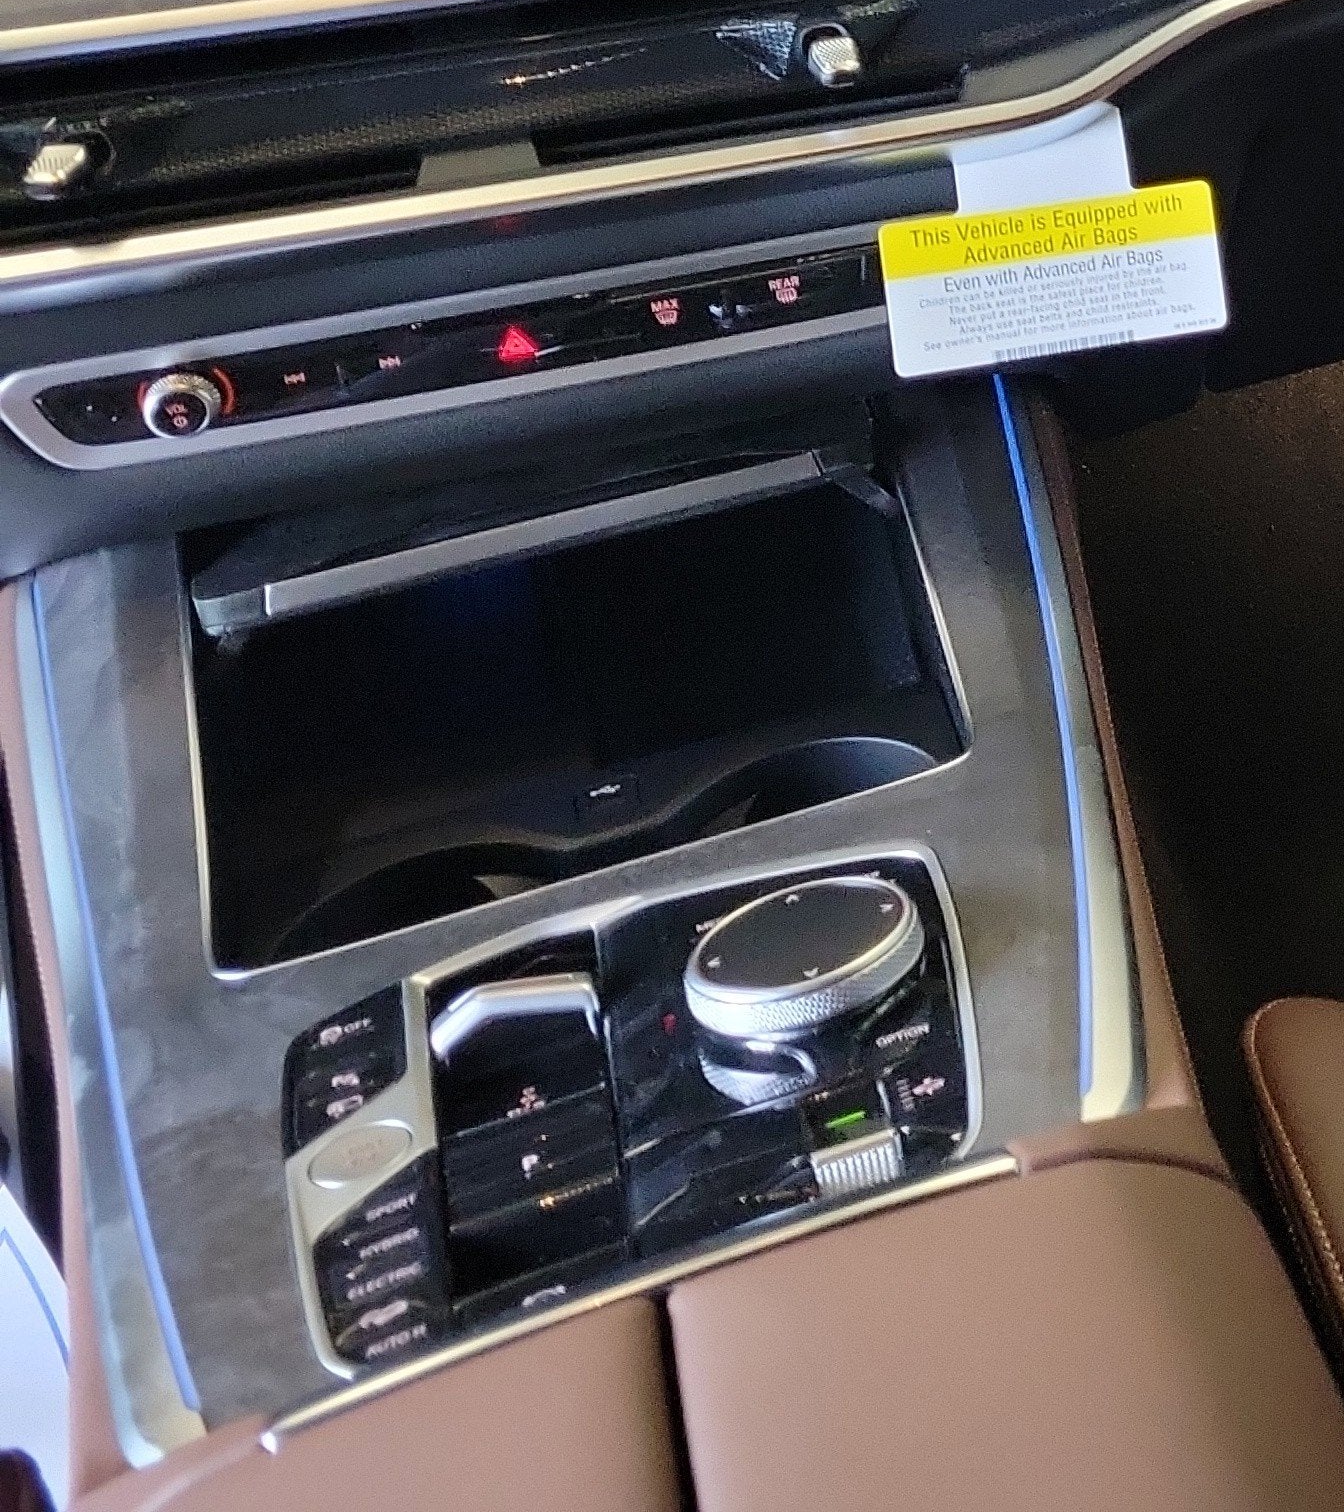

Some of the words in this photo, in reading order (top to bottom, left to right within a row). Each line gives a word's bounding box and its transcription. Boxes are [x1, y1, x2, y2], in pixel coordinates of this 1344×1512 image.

[909, 226, 950, 249] This
[955, 216, 1024, 242] Vehicle
[1030, 213, 1047, 232] is
[1051, 198, 1138, 230] Equipped
[1143, 193, 1183, 215] with
[963, 235, 1054, 265] Advanced
[1061, 231, 1086, 252] Air
[1093, 226, 1138, 246] Bags
[768, 275, 800, 292] REAR
[943, 275, 981, 292] Even
[984, 268, 1018, 287] with
[1023, 255, 1096, 282] Advanced
[1101, 253, 1121, 270] Air
[1126, 248, 1163, 267] Bags
[650, 297, 680, 313] MAX
[923, 340, 942, 352] See
[875, 1022, 931, 1049] OPTION
